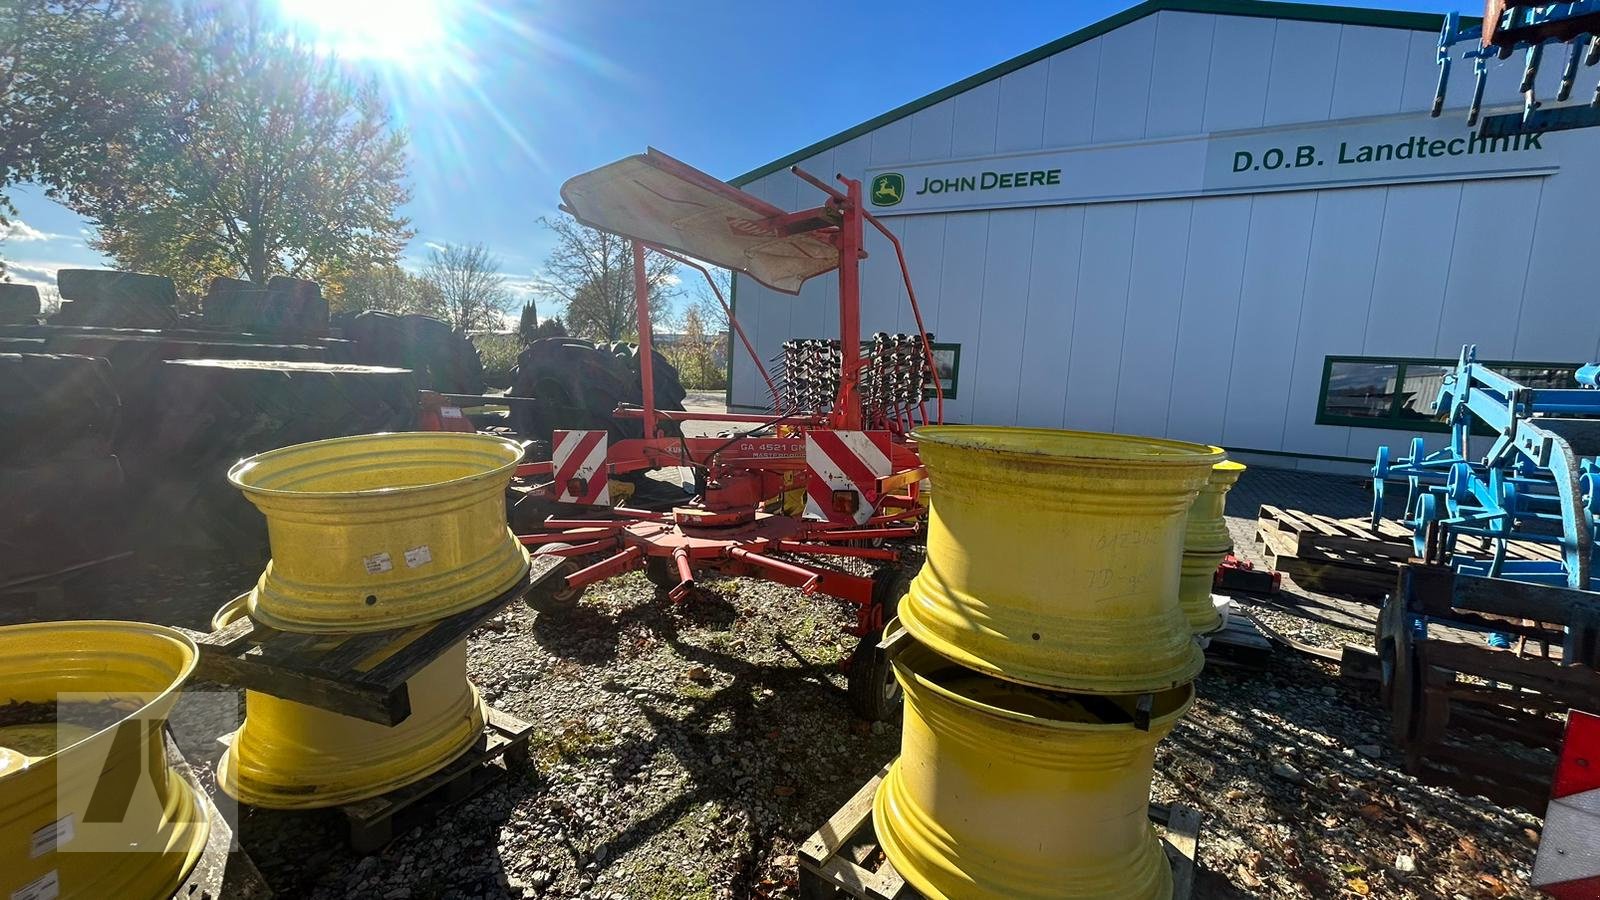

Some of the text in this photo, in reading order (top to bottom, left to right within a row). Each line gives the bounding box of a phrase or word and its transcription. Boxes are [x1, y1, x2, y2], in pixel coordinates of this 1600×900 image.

[1233, 131, 1543, 173] D.O.B. Landtechnik
[916, 169, 1062, 196] JOHN DEERE
[740, 443, 754, 452] GA
[759, 443, 787, 452] 4521
